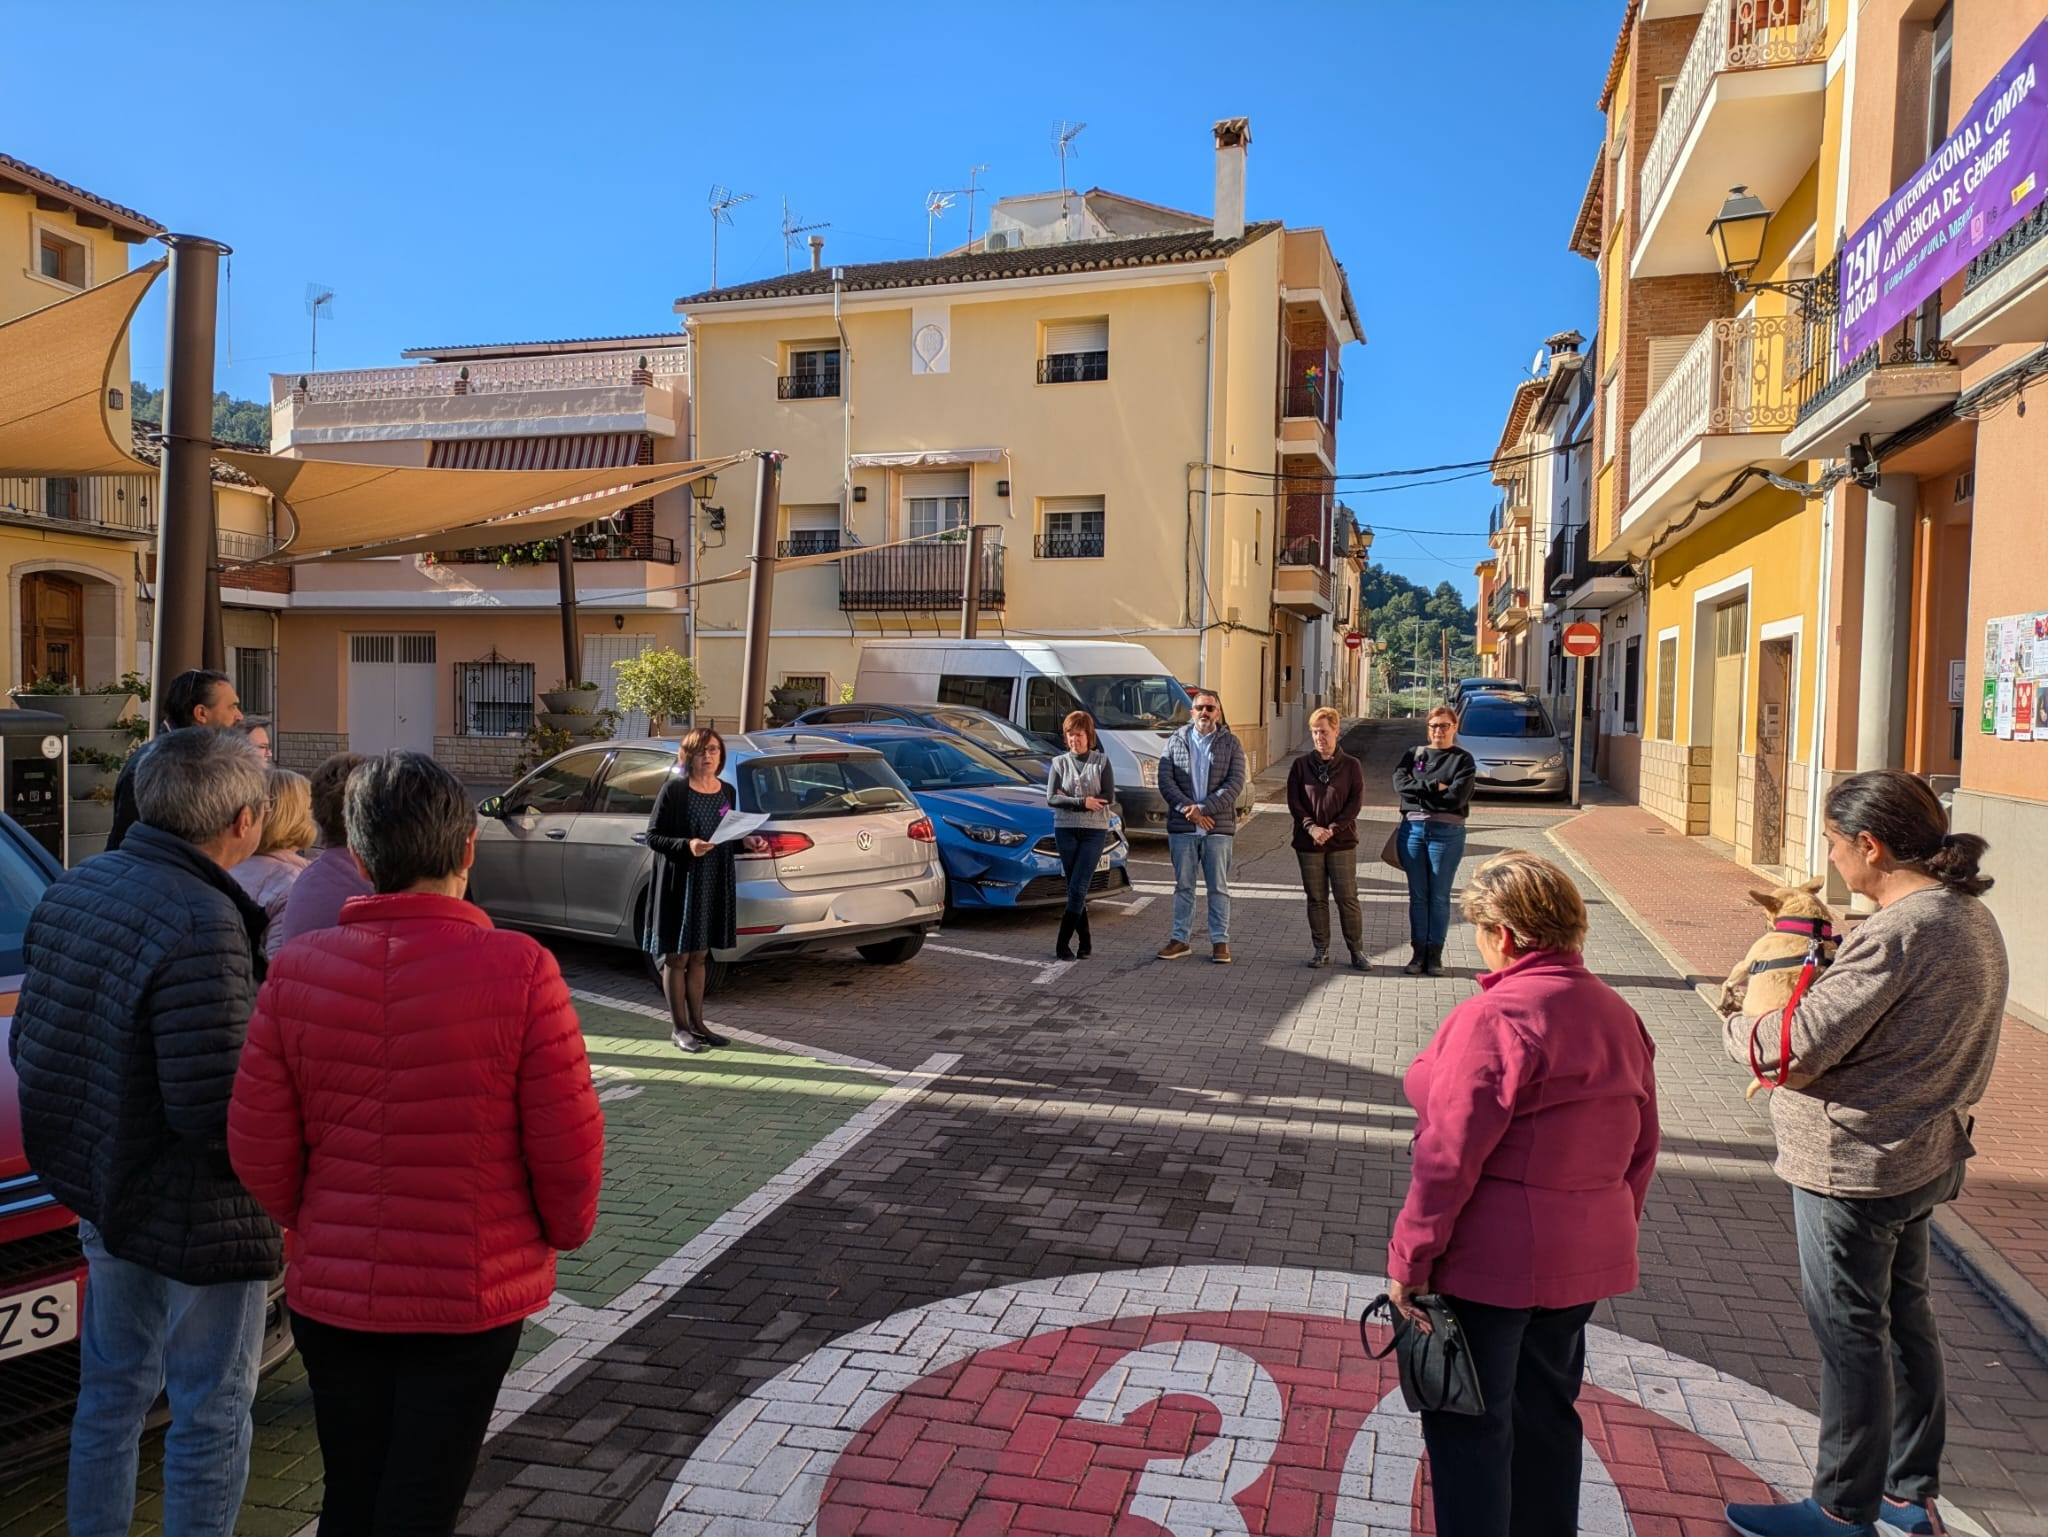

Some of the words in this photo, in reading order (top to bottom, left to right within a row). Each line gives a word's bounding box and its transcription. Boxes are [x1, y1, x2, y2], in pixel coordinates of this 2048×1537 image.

[1882, 209, 1895, 239] DIA
[1895, 121, 1981, 223] INTERNACIONAL
[1984, 63, 2036, 134] CONTRA
[1882, 246, 1896, 273] LA
[1895, 197, 1941, 261] VIOLÈNCIA
[1942, 178, 1962, 213] DE
[1963, 129, 2011, 193] GÈNERE
[1846, 223, 1882, 300] 25N
[1926, 229, 1948, 256] UNA
[1844, 275, 1878, 328] OLOCAU
[17, 793, 24, 802] A
[45, 791, 52, 800] B
